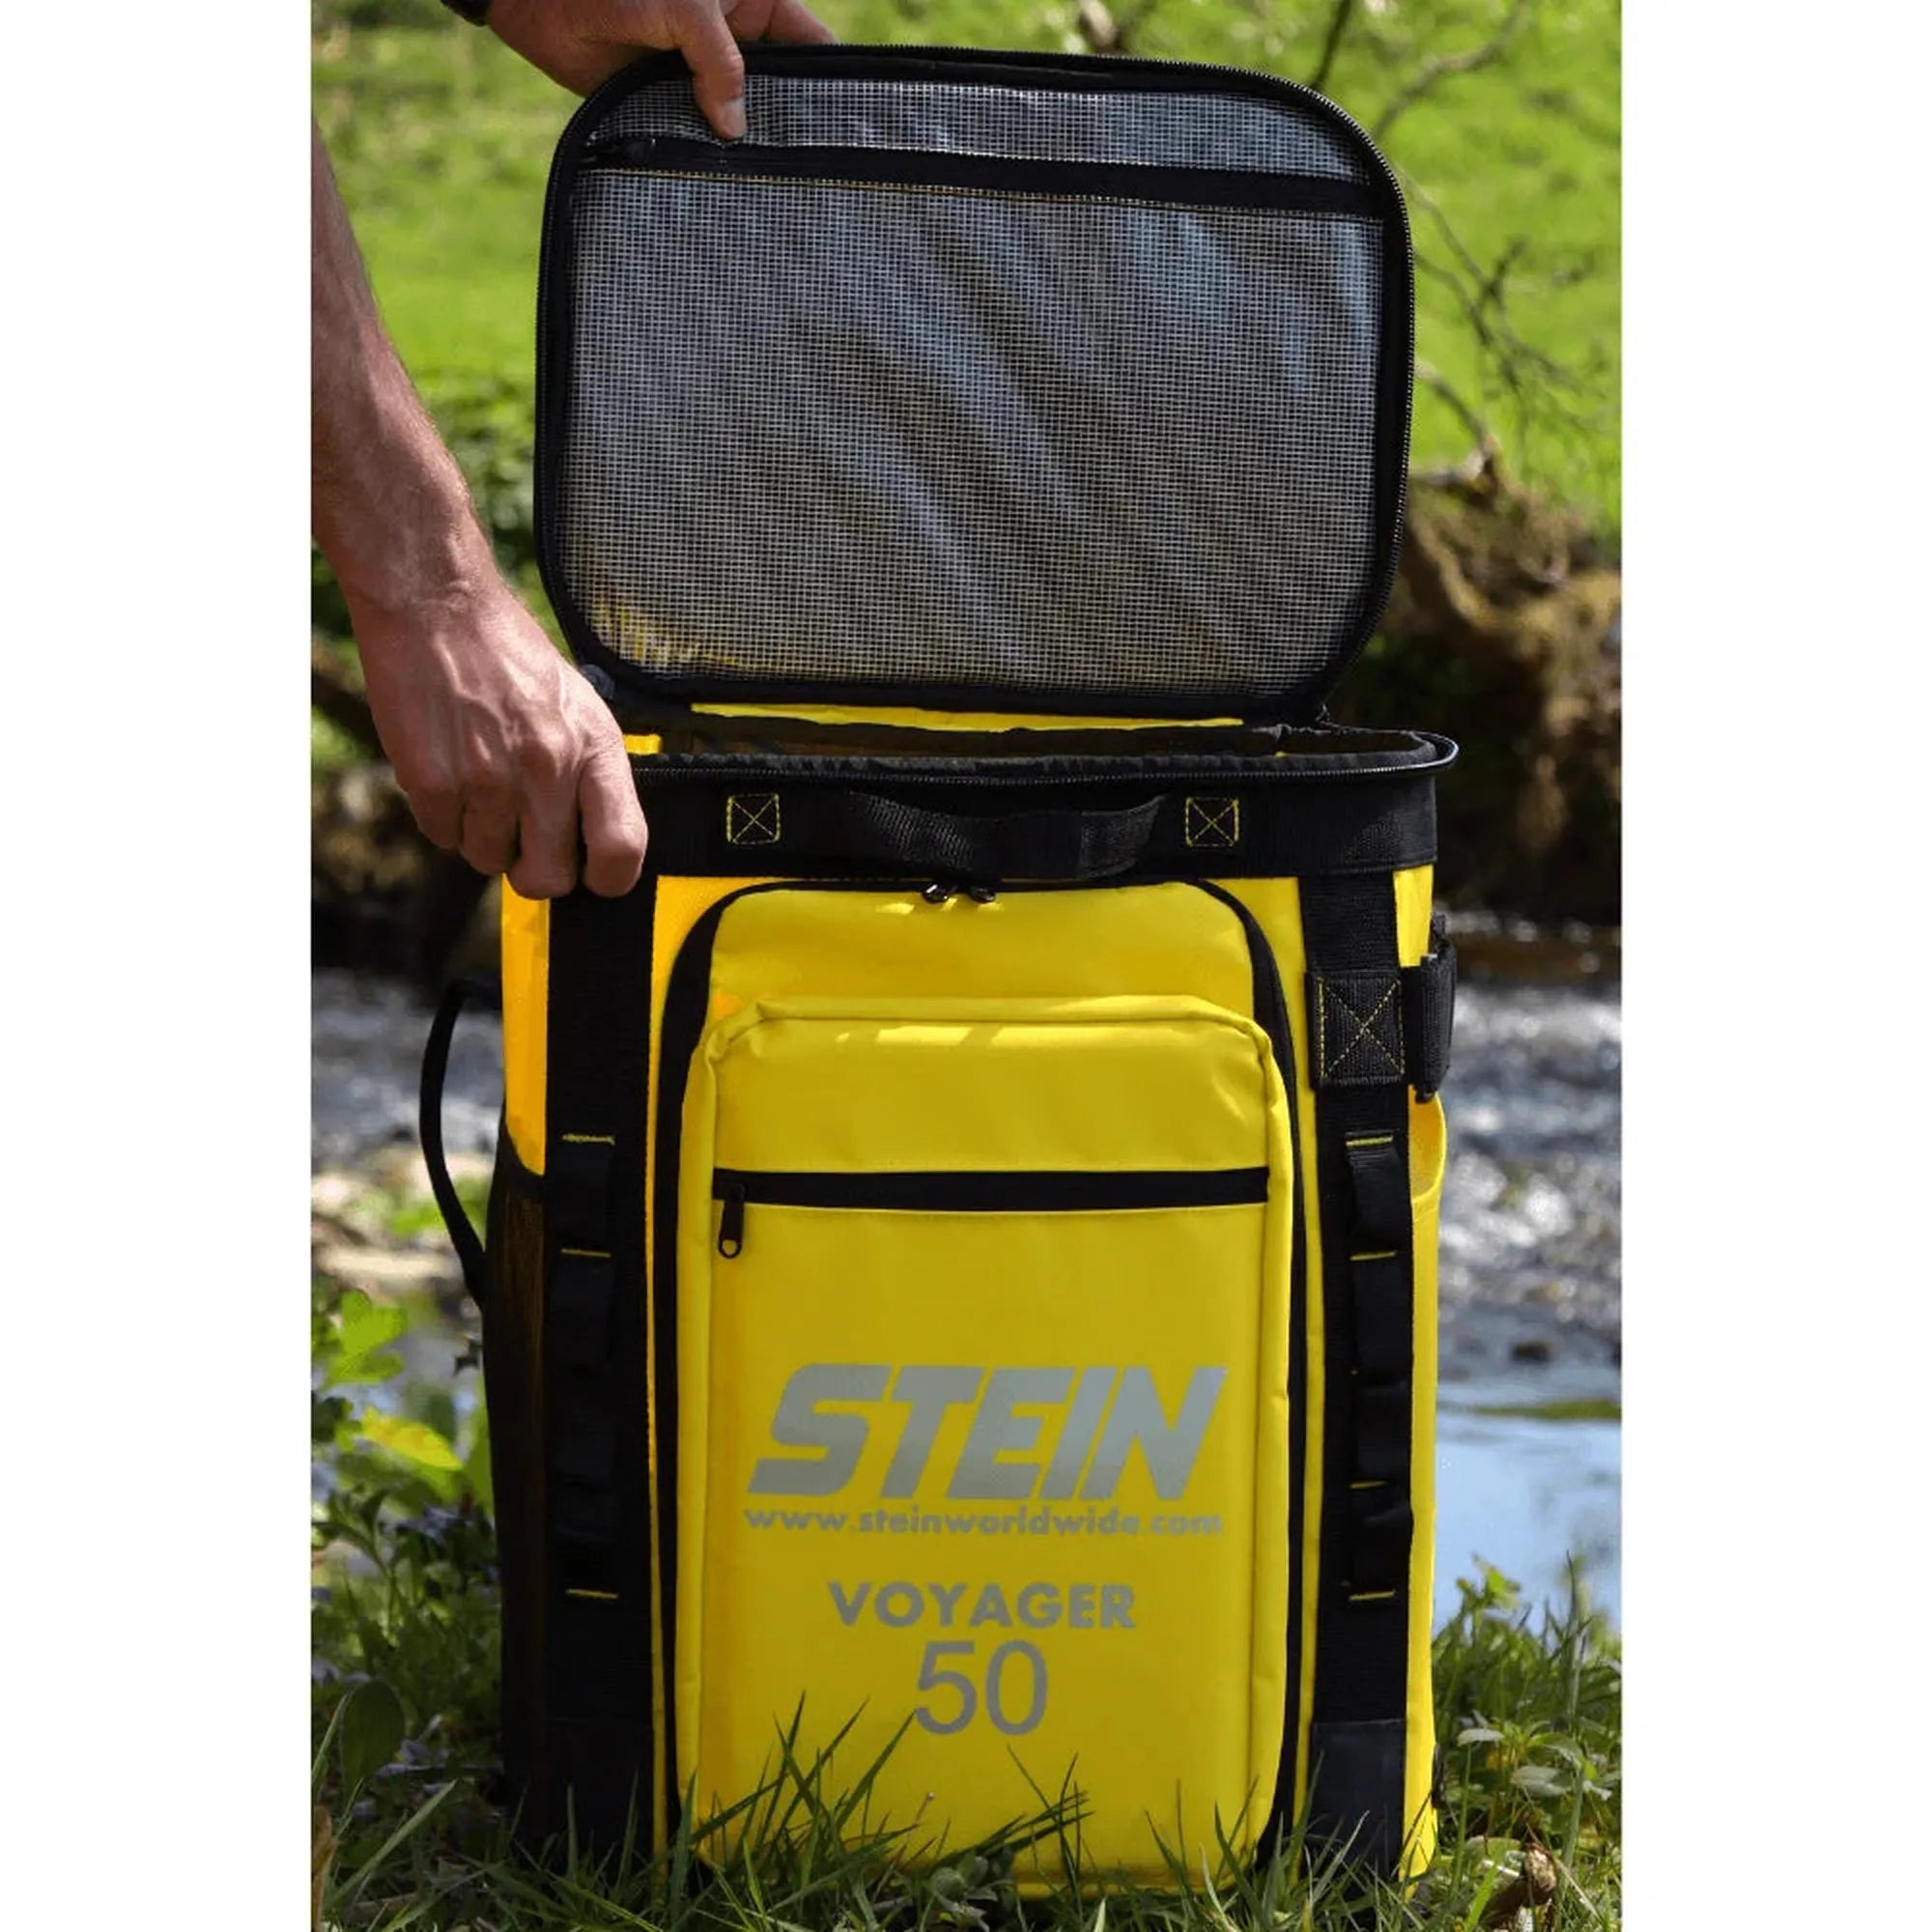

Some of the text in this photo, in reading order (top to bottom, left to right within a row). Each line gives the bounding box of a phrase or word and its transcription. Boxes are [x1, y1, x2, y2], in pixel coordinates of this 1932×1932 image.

[747, 1362, 1228, 1500] STEIN
[743, 1504, 1223, 1536] www.steinworldwide.com
[828, 1581, 1137, 1629] VOYAGER
[914, 1639, 1049, 1736] 50
